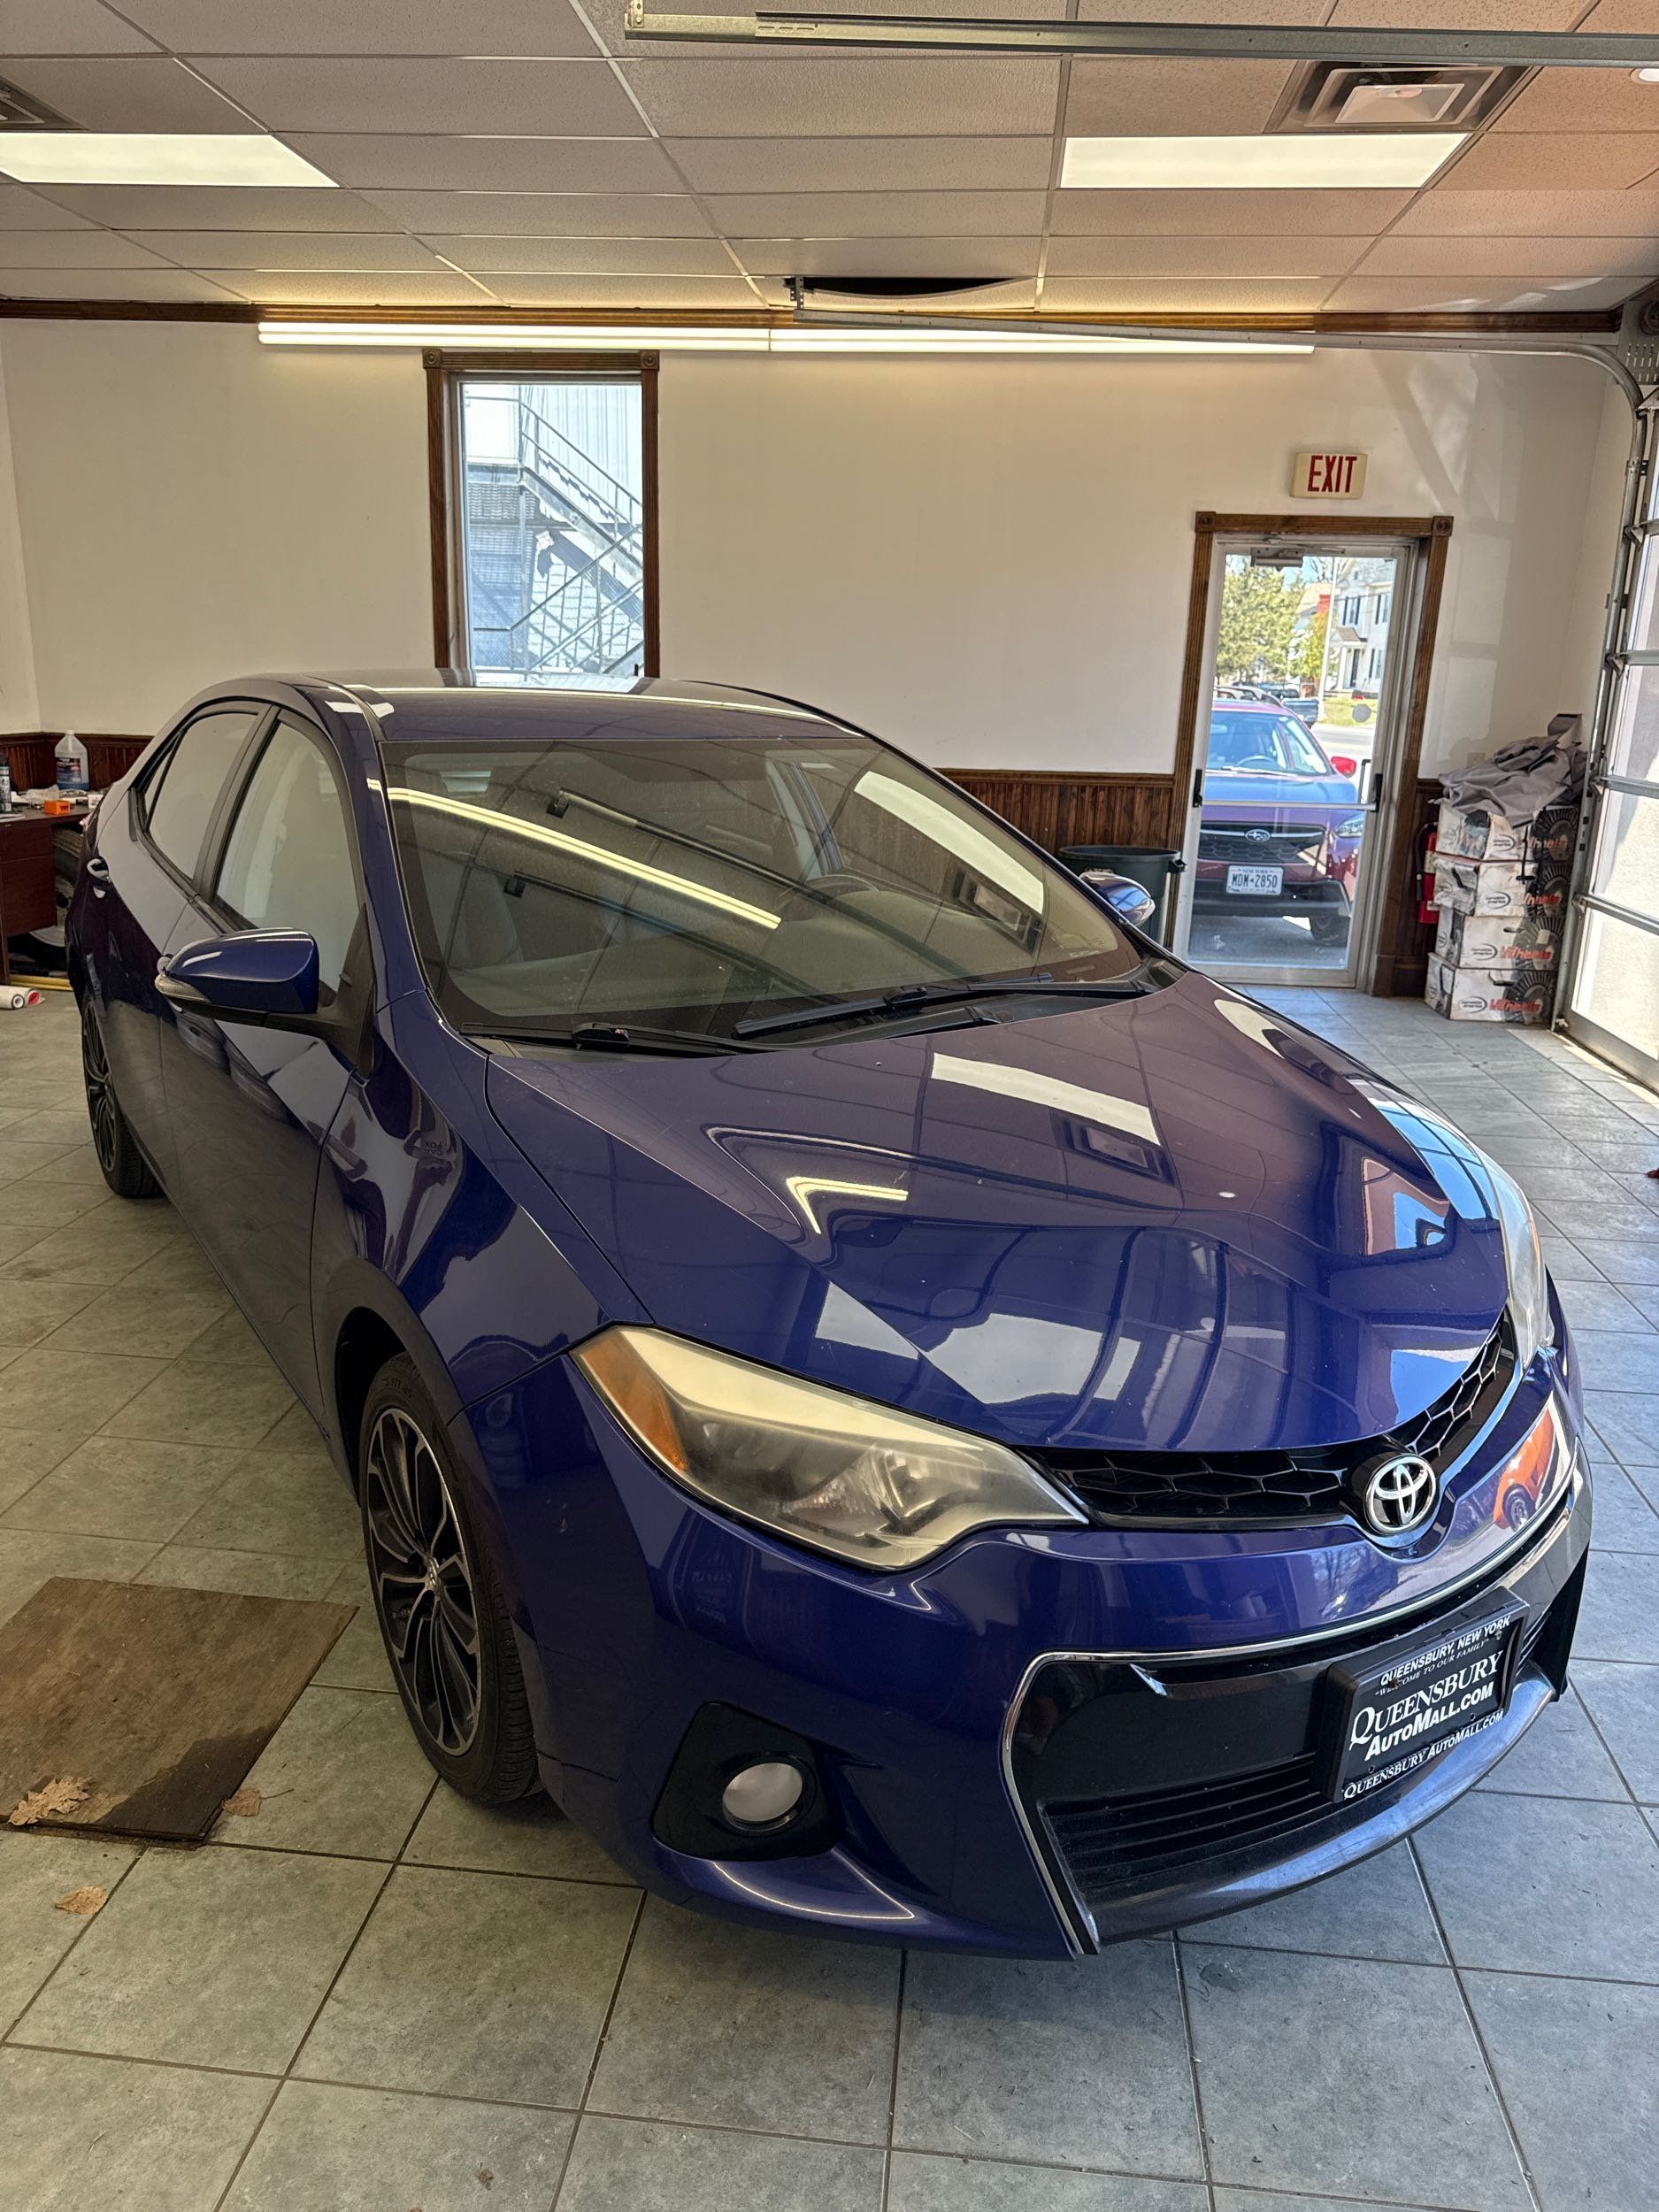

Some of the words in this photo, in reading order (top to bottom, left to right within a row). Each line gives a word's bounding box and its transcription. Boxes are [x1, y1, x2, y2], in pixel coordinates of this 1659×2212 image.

[1308, 455, 1357, 493] EXIT
[1255, 874, 1278, 888] 2850
[1380, 1641, 1455, 1686] QUEENSBURY,
[1457, 1629, 1483, 1649] NEW
[1484, 1615, 1511, 1637] YORK
[1424, 1665, 1435, 1675] TO
[1437, 1655, 1455, 1667] OUR
[1348, 1649, 1504, 1751] QUEENSBURY
[1364, 1681, 1494, 1762] AUTOMALL.COM
[1343, 1749, 1427, 1800] QUEENSBURY
